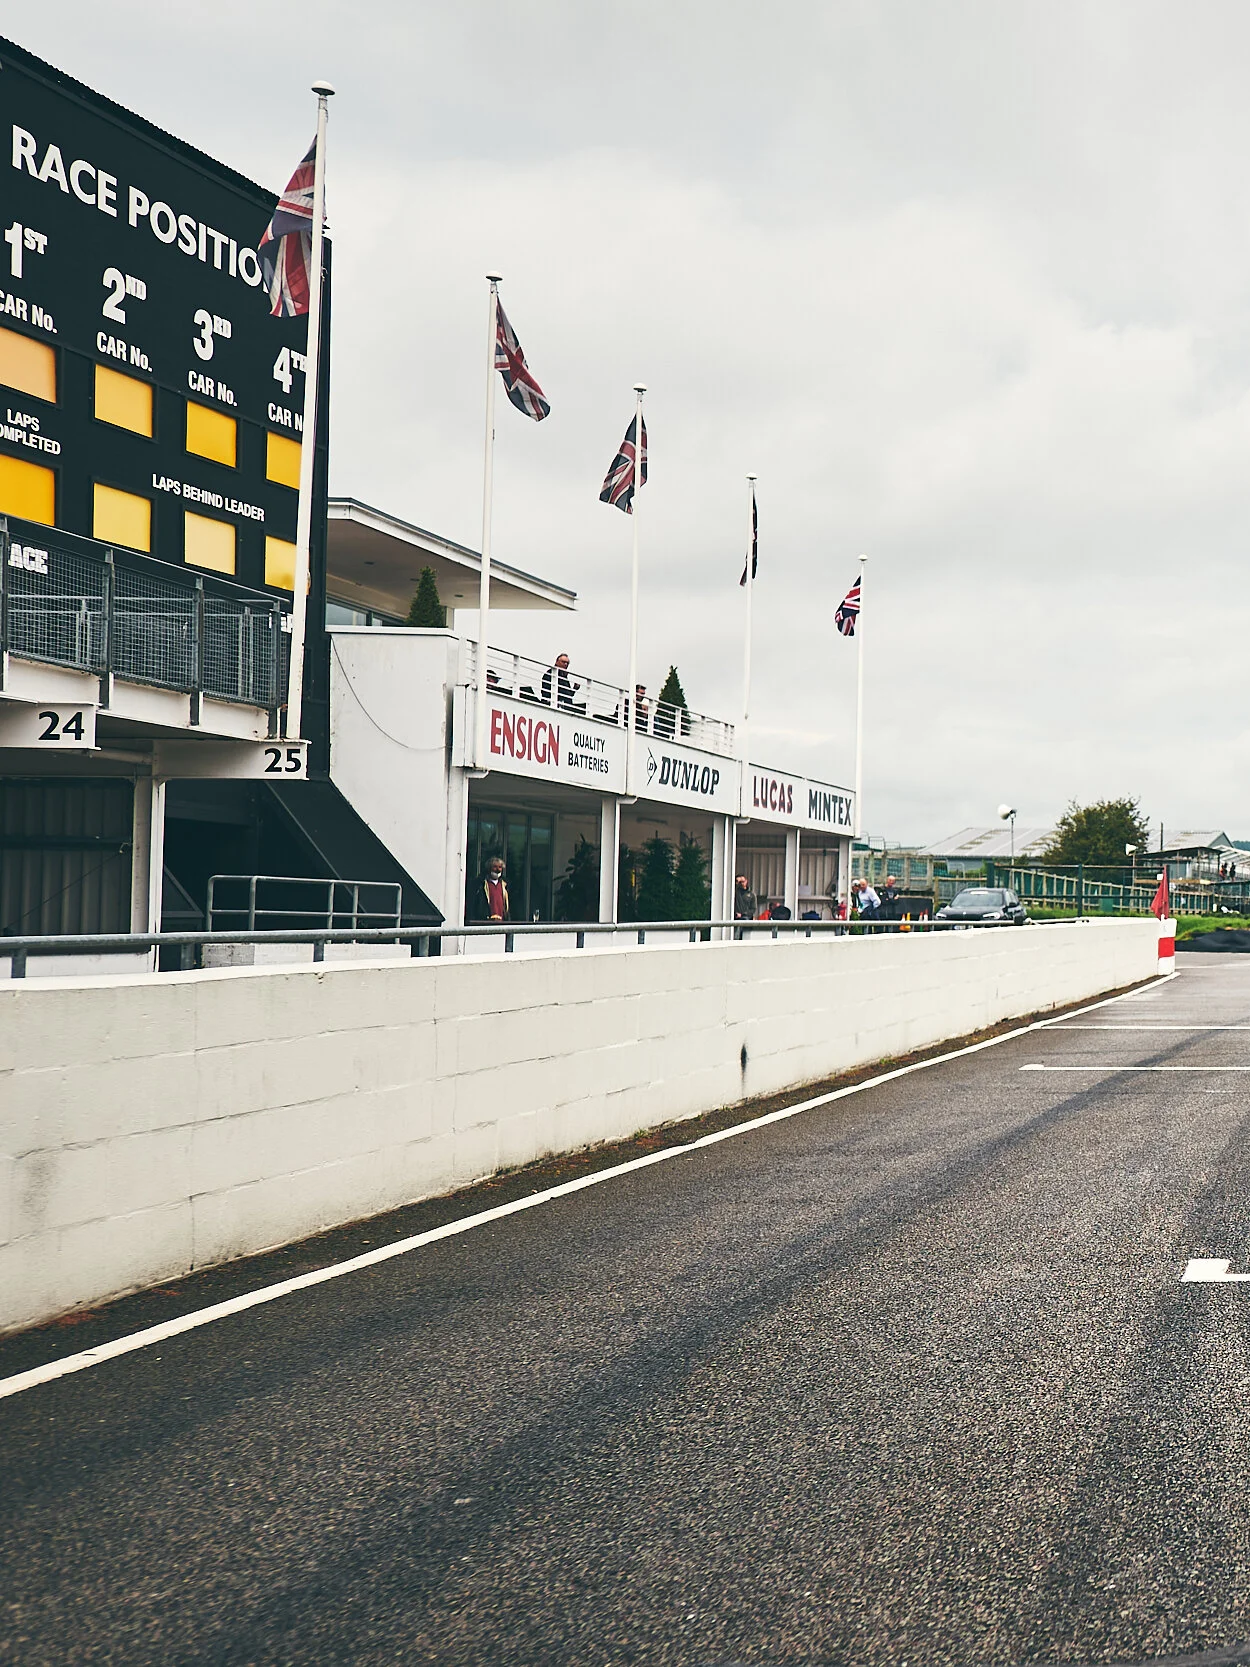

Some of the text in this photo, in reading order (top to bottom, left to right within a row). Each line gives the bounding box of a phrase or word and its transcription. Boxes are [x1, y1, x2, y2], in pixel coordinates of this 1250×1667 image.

[11, 124, 269, 294] RACE POSITIO
[4, 221, 48, 279] 1ST
[102, 267, 147, 325] 2ND
[31, 304, 58, 334] No.
[193, 308, 232, 361] 3RD
[96, 331, 153, 373] CAR No.
[188, 370, 238, 407] CAR No.
[7, 408, 40, 432] LAPS
[267, 402, 292, 428] CAR
[152, 473, 265, 522] LAPS BEHIND LEADER
[38, 710, 85, 742] 24
[490, 708, 560, 767] ENSIGN
[573, 732, 605, 753] QUALITY
[264, 748, 301, 773] 25
[567, 751, 609, 774] BATTERIES
[658, 756, 720, 796] DUNLOP
[753, 775, 793, 815] LUCAS
[808, 788, 852, 827] MINTEX
